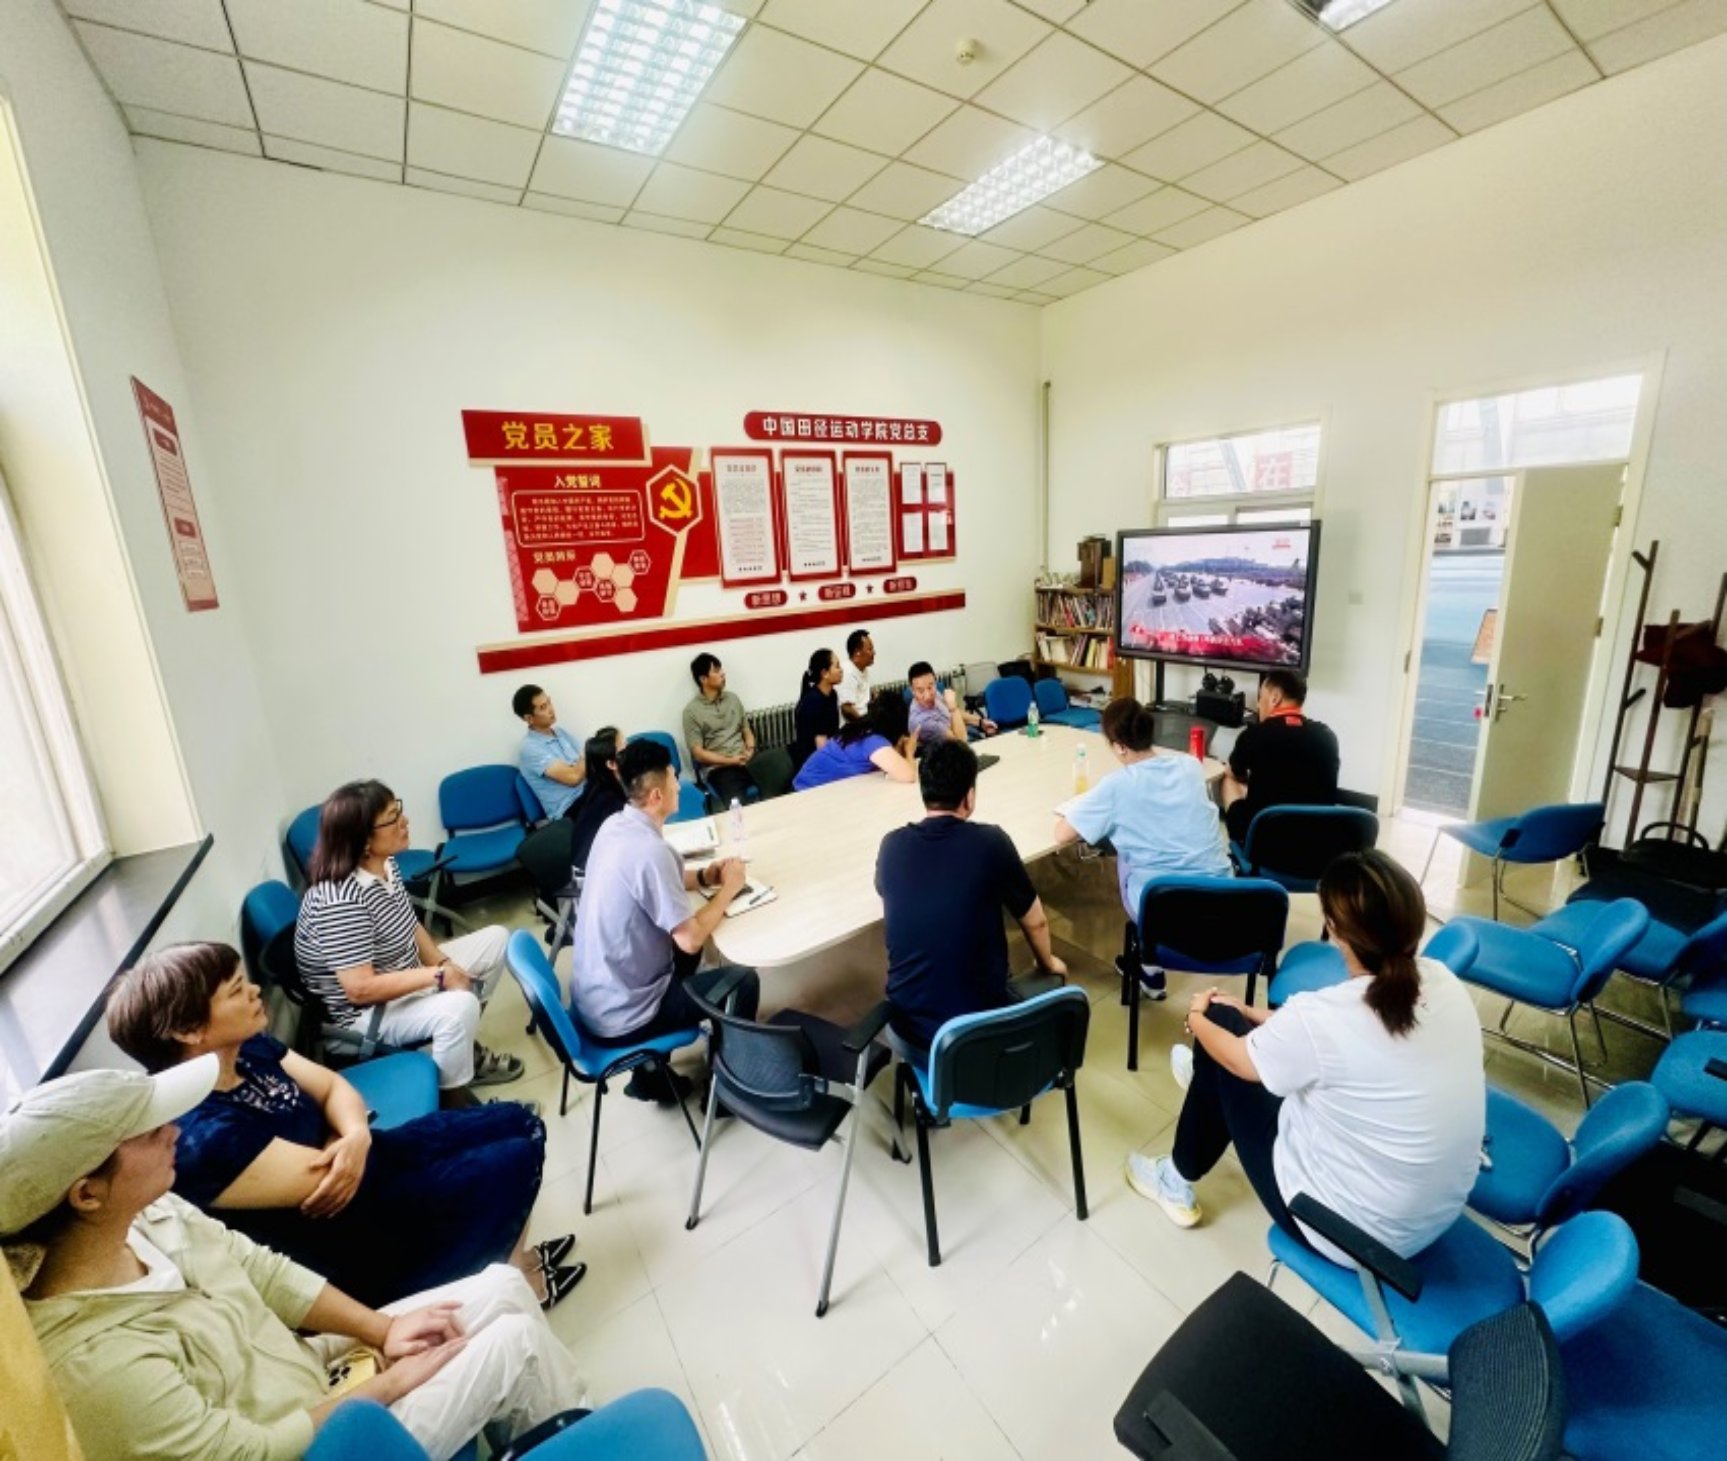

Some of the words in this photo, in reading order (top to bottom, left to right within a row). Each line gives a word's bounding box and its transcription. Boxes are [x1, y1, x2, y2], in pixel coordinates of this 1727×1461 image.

[501, 421, 614, 452] 党员之家
[762, 416, 930, 441] 中国田径运动学院党总支
